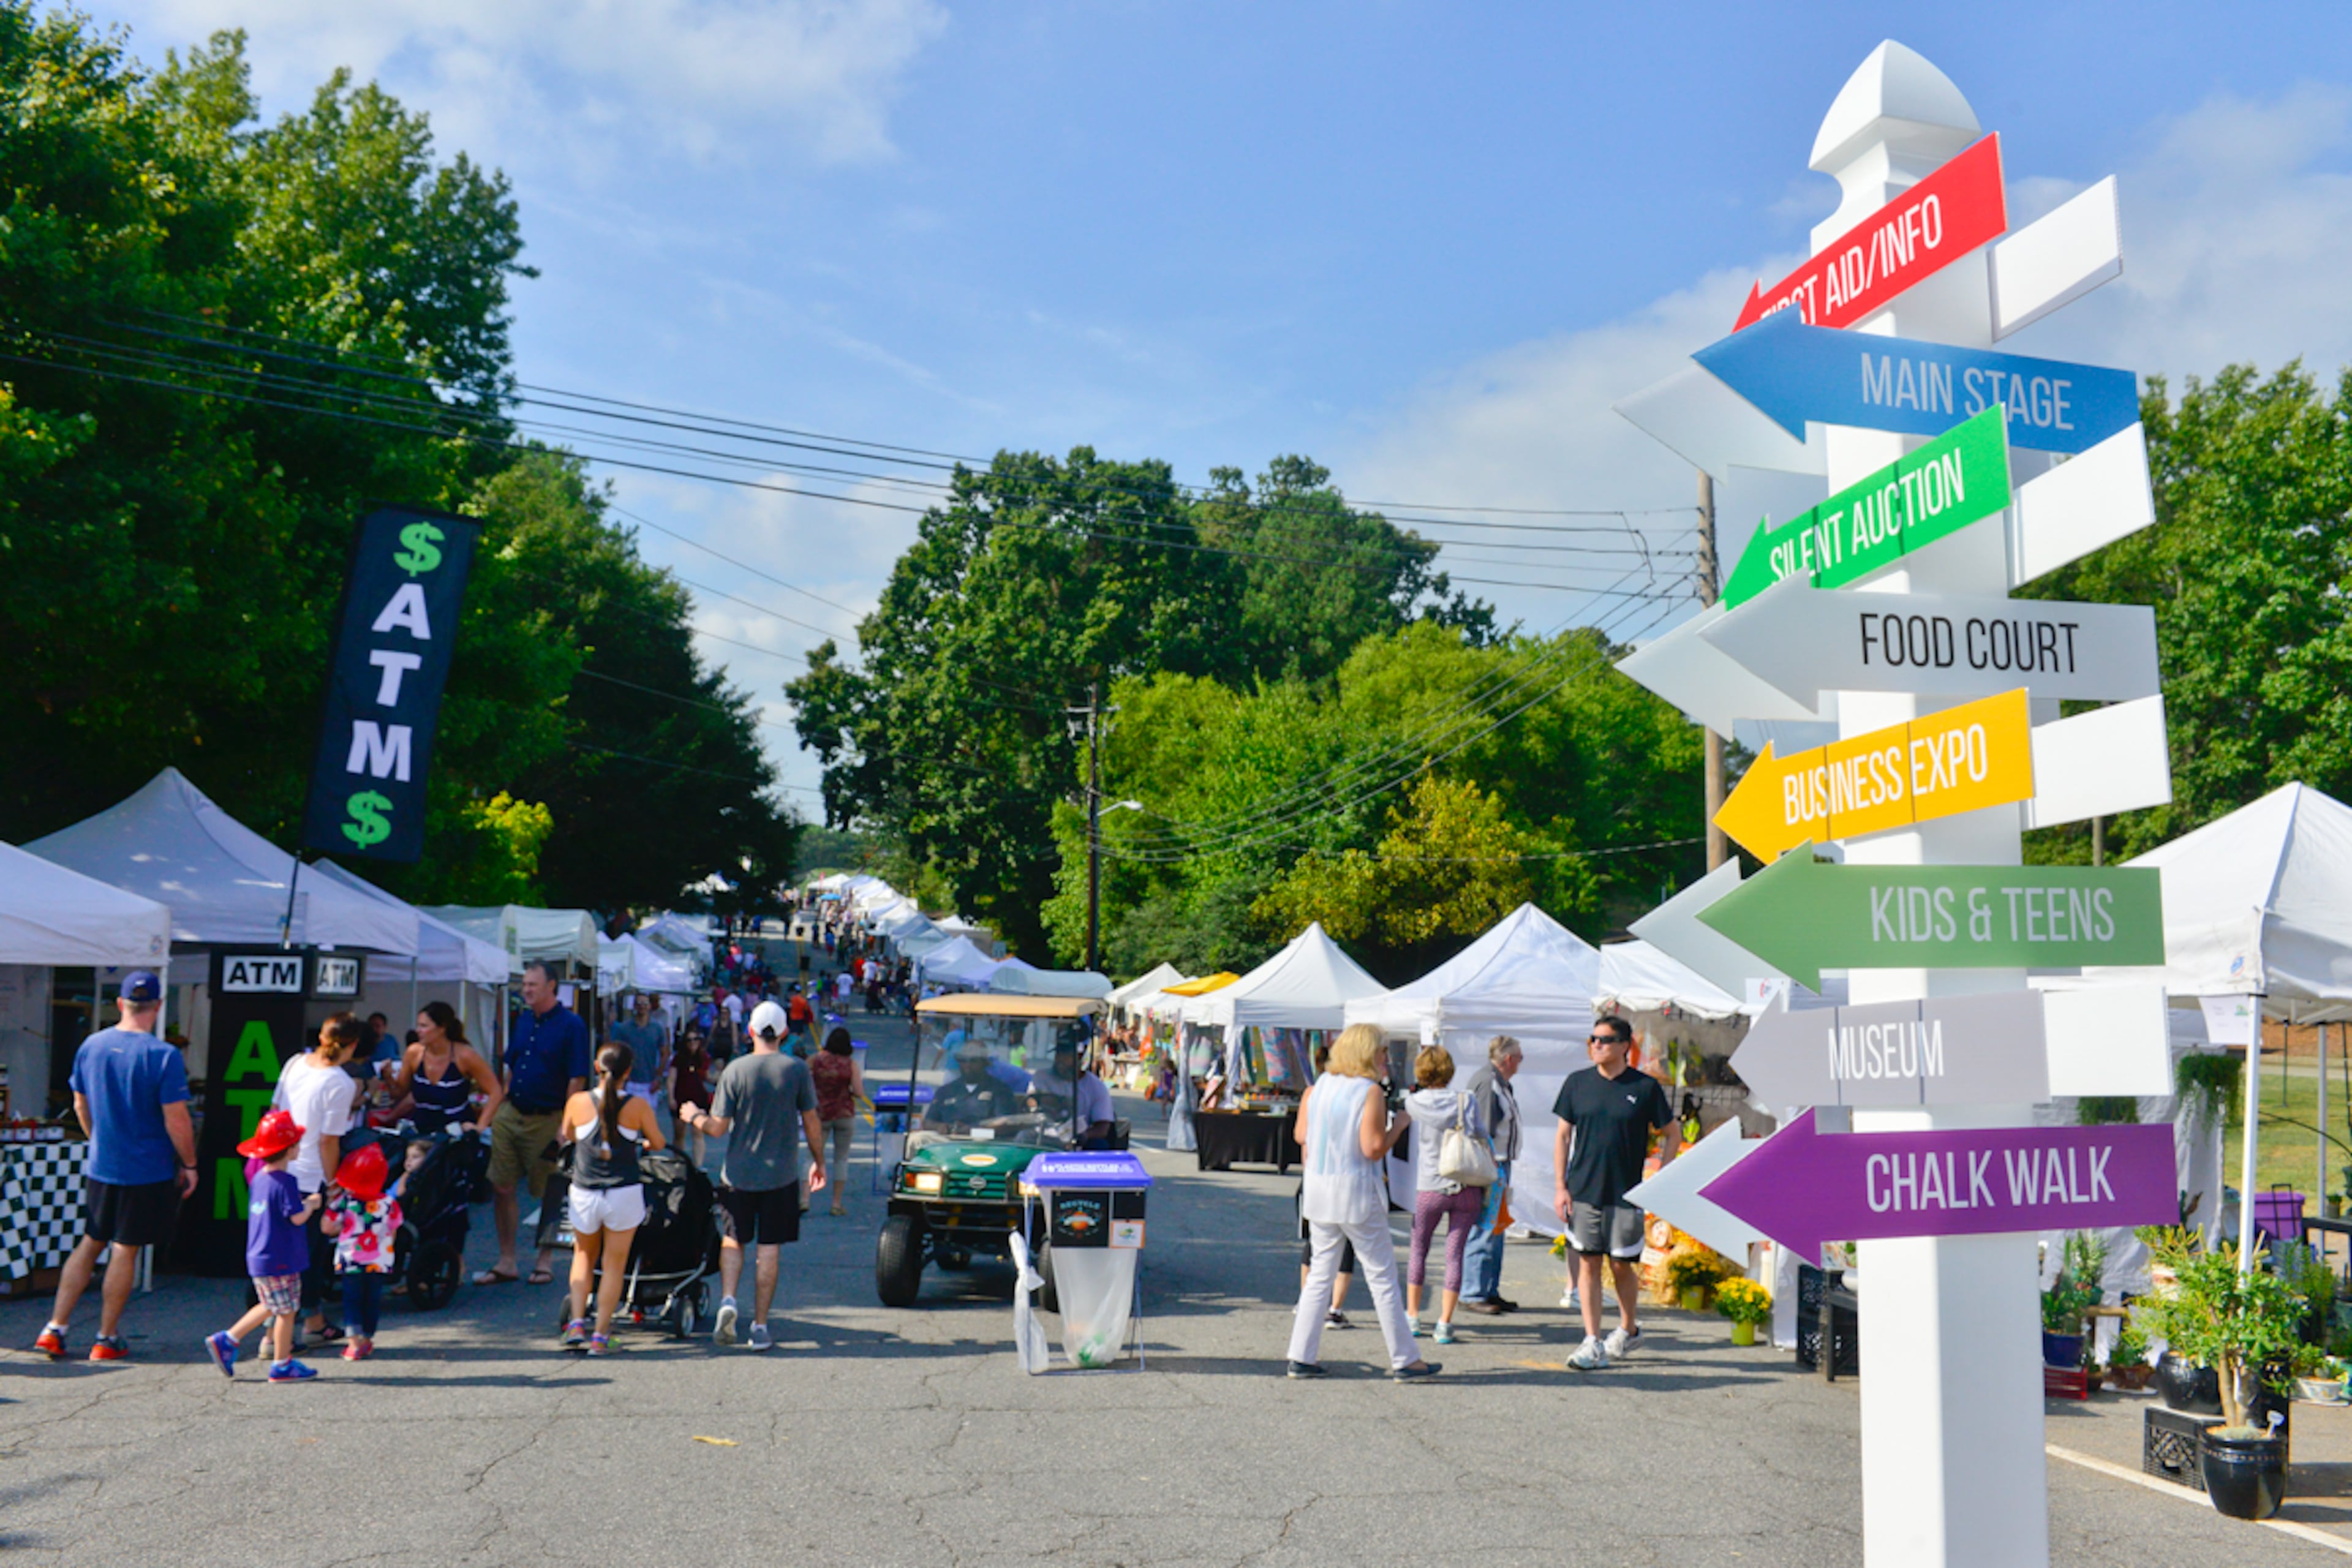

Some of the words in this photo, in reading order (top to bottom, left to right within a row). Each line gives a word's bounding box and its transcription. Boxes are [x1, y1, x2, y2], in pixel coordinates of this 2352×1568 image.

[1826, 194, 1942, 315] AID/INFO
[1861, 352, 1953, 414] MAIN
[1964, 368, 2074, 429] STAGE
[1770, 511, 1844, 586] SILENT
[1852, 447, 1964, 555] AUCTION
[1860, 613, 1954, 668] FOOD
[1966, 618, 2079, 673] COURT
[1783, 746, 1903, 826] BUSINESS
[1909, 723, 1988, 796] EXPO
[1870, 886, 1957, 942] KIDS
[1967, 887, 1992, 942] &
[2001, 888, 2114, 941] TEENS
[228, 961, 297, 986] ATM
[318, 963, 355, 988] ATM
[1828, 1020, 1944, 1080] MUSEUM
[1866, 1148, 1994, 1212] CHALK
[2004, 1147, 2115, 1205] WALK
